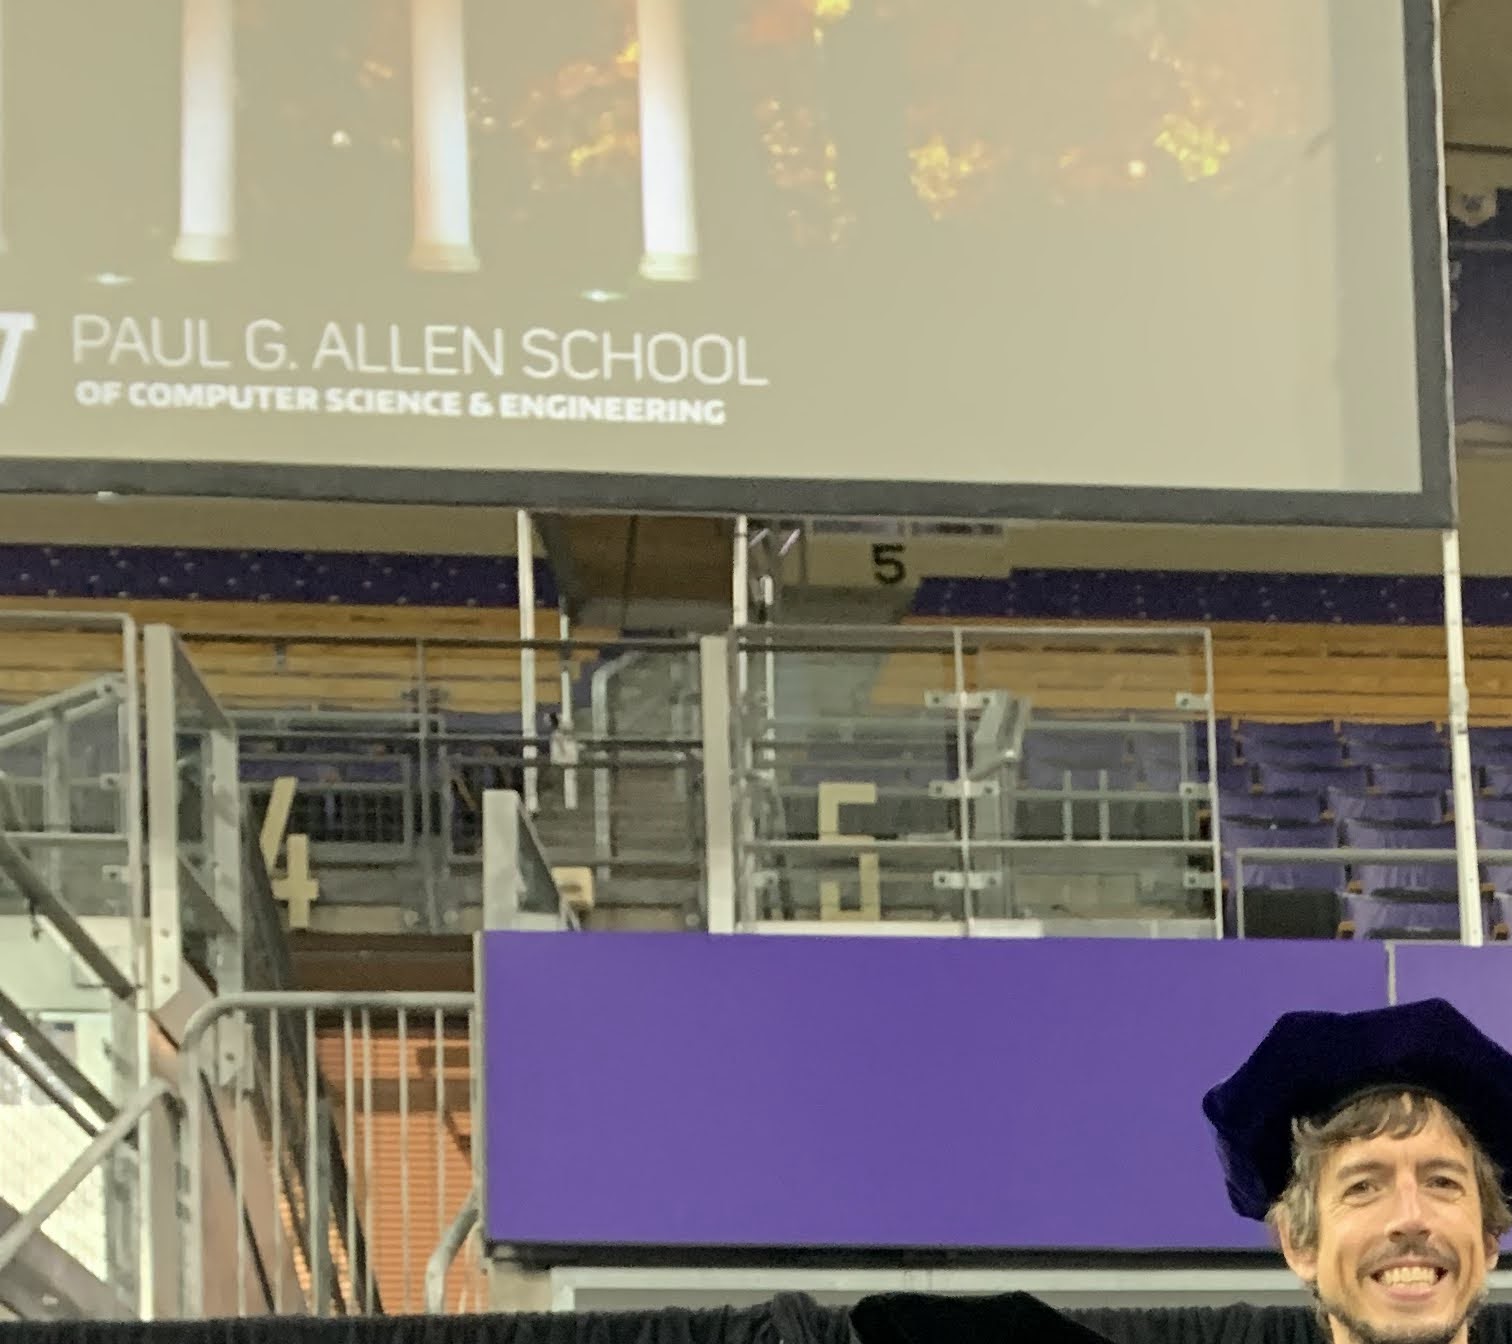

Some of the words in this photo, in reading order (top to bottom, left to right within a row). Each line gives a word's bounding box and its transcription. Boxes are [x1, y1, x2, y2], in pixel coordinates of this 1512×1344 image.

[73, 314, 231, 368] PAUL
[245, 318, 298, 371] G.
[312, 321, 504, 377] ALLEN
[521, 327, 770, 386] SCHOOL
[75, 380, 122, 406] OF
[128, 382, 319, 412] COMPUTER
[325, 386, 461, 417] SCIENCE
[468, 392, 494, 418] &
[500, 392, 727, 426] ENGINEERING
[872, 543, 906, 585] 5
[259, 776, 320, 928] 4
[818, 781, 881, 922] 5
